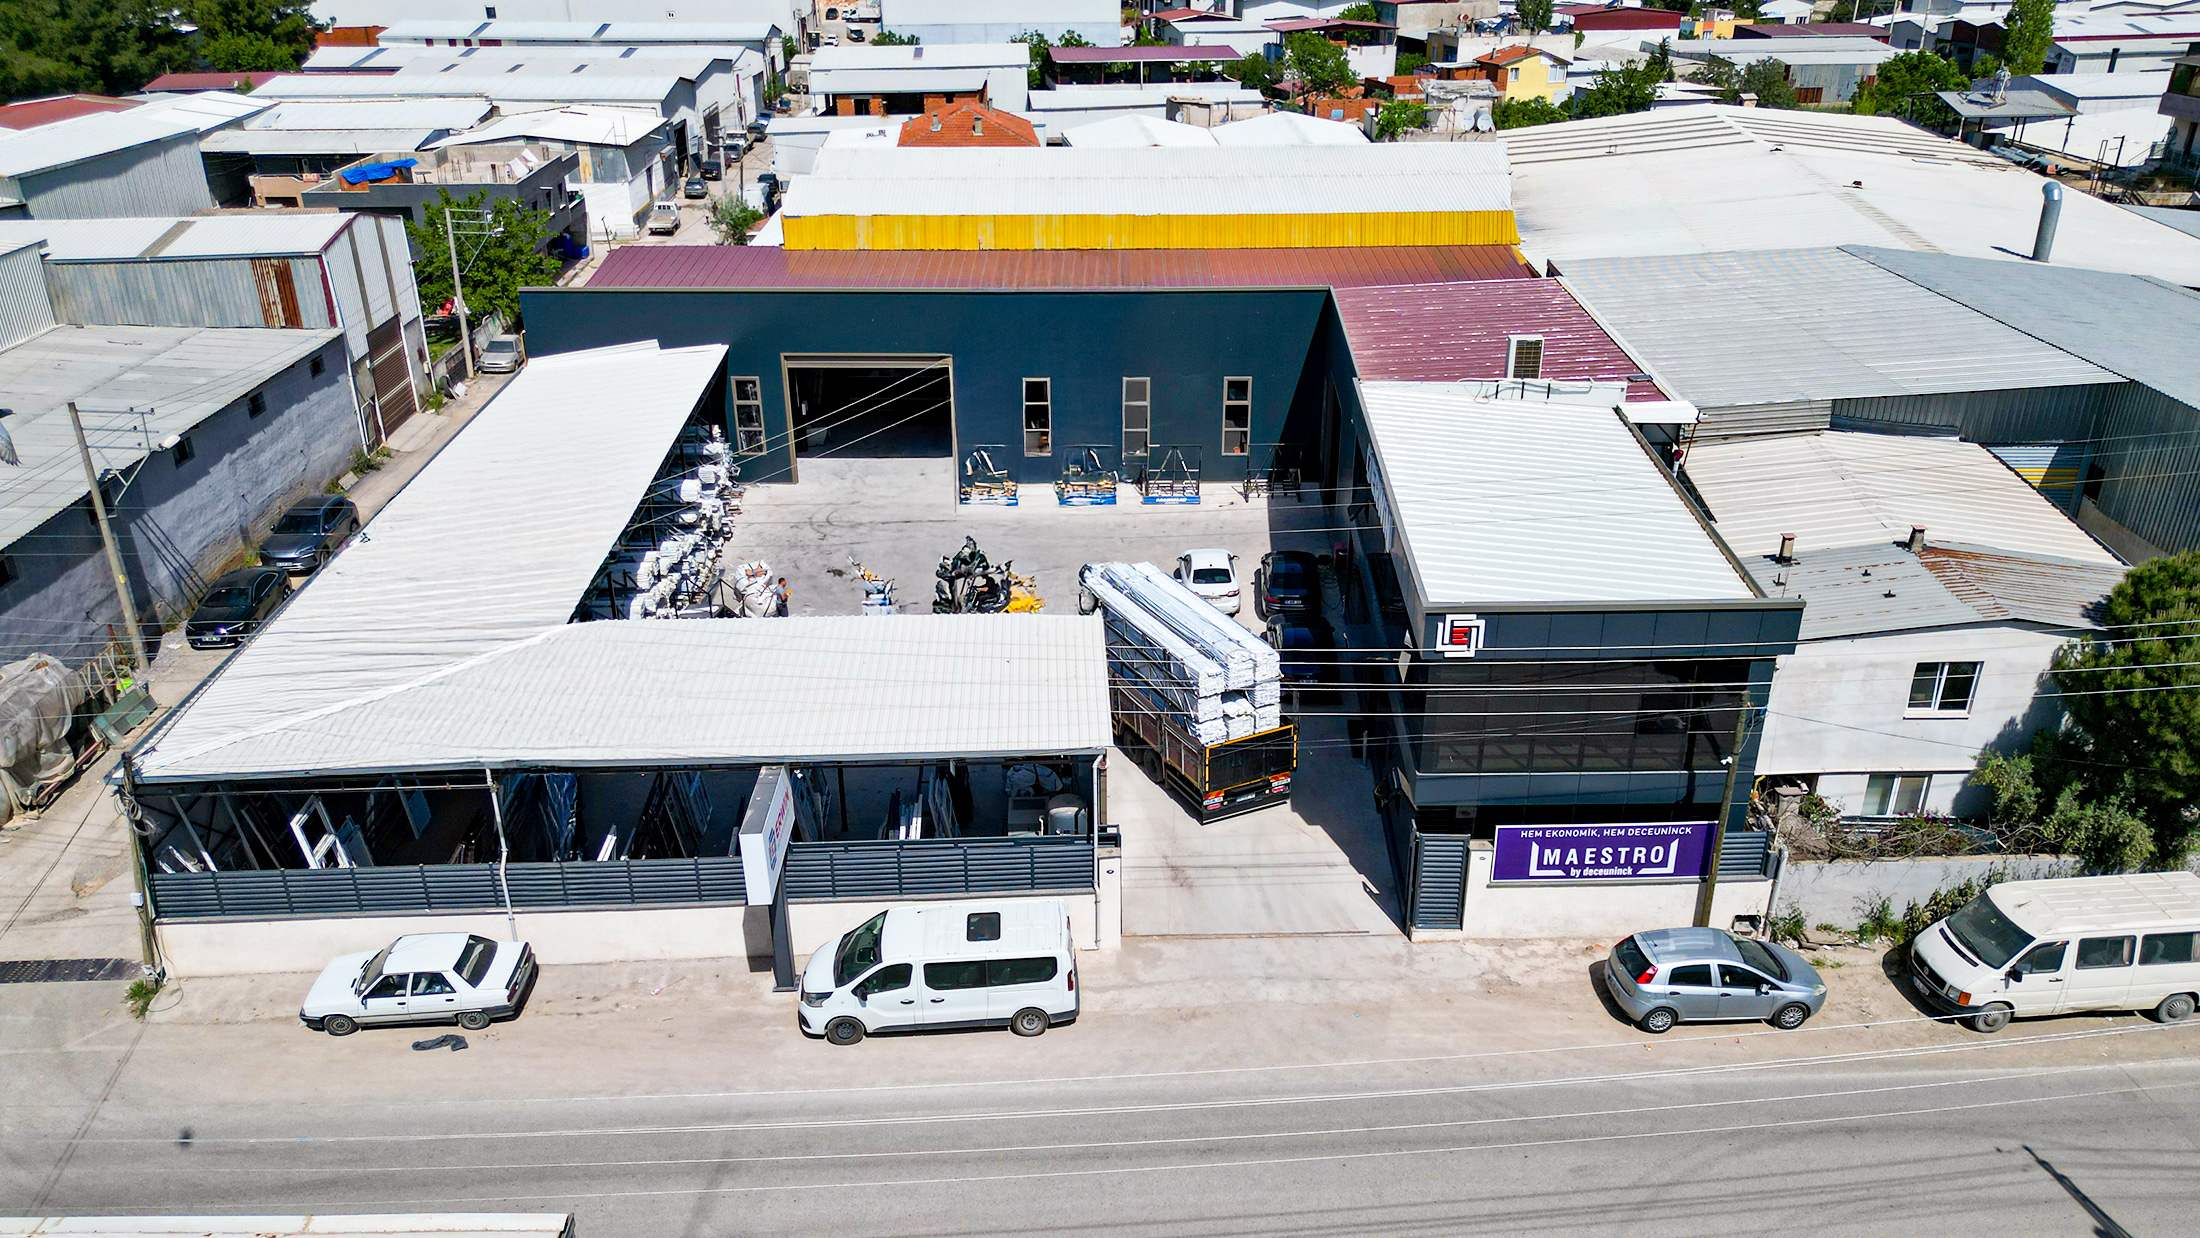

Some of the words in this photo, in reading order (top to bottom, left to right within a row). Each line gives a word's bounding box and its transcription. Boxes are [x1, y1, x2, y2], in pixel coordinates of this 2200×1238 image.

[1520, 829, 1543, 838] HEM
[1545, 827, 1601, 838] EKONOMİK,
[1603, 828, 1625, 837] HEM
[1627, 826, 1693, 837] DECEUNİNCK
[1542, 845, 1665, 866] MAESTRO
[1570, 866, 1581, 878] by
[1582, 866, 1633, 876] deceuninck
